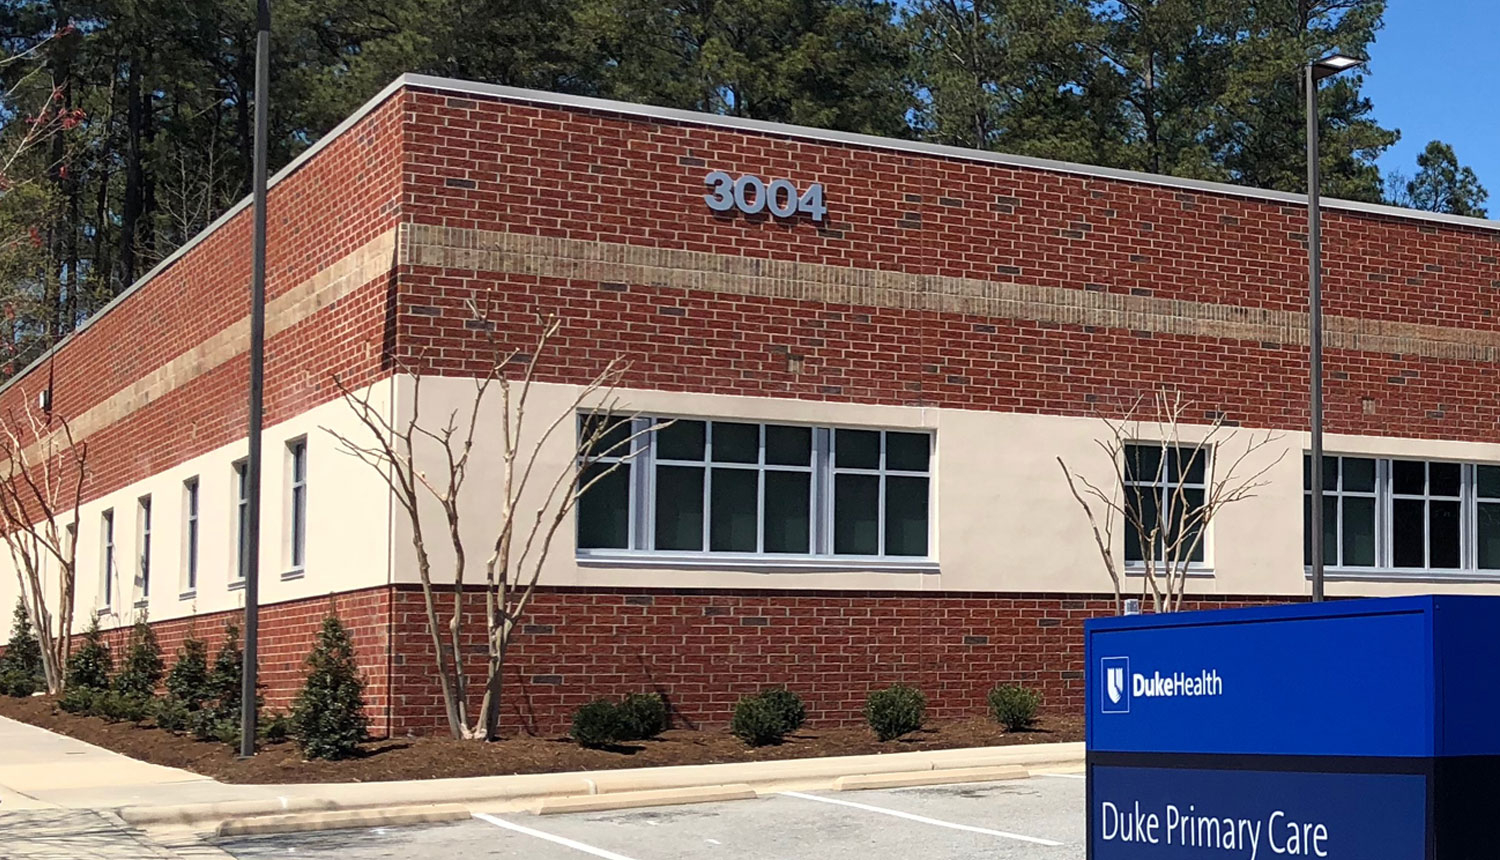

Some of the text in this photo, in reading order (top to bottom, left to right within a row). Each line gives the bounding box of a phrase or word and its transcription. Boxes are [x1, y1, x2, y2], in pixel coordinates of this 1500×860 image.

[704, 171, 827, 220] 3004
[1132, 669, 1222, 697] DukeHealth
[1102, 800, 1328, 860] Duke Primary Care
